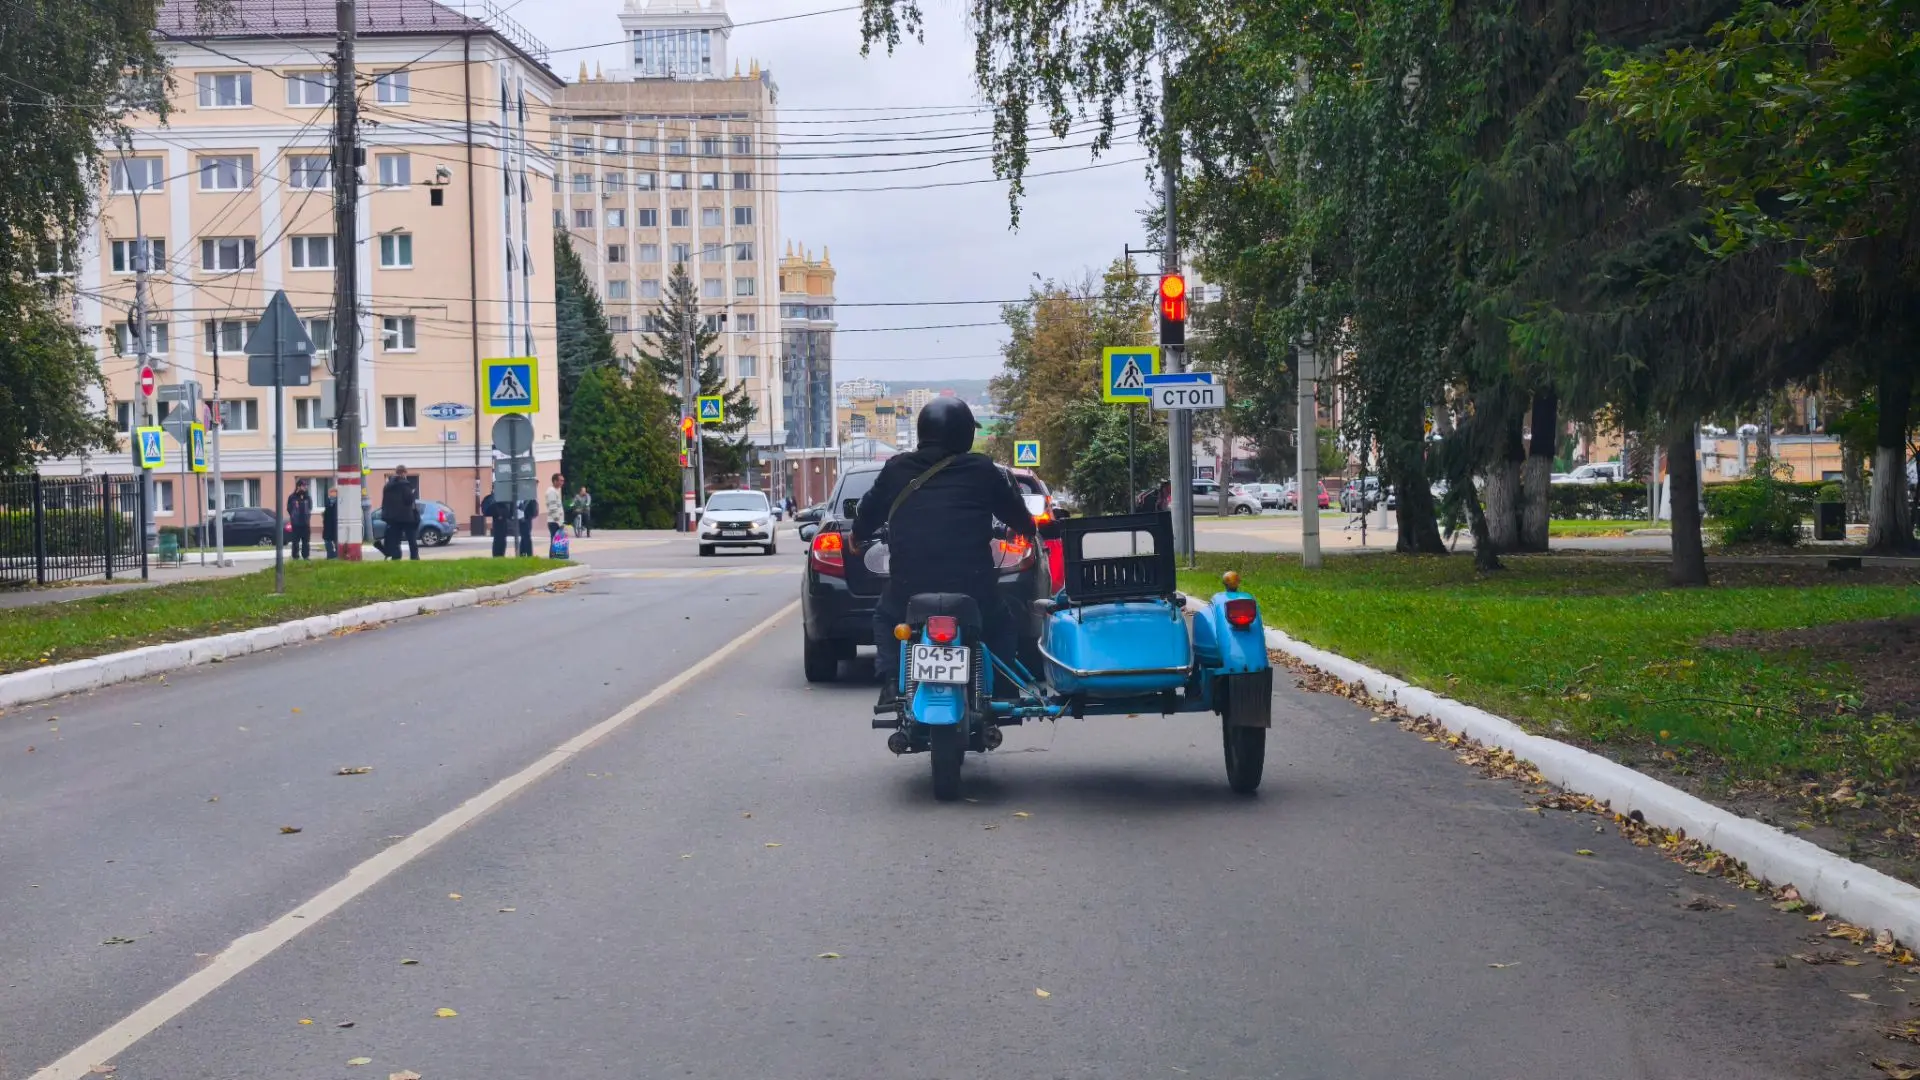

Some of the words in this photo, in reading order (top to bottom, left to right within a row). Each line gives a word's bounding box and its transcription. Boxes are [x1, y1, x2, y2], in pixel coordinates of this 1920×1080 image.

[1165, 301, 1184, 320] 41
[1163, 389, 1214, 406] СТОП
[918, 647, 965, 662] 0451
[918, 664, 962, 680] МРГ
